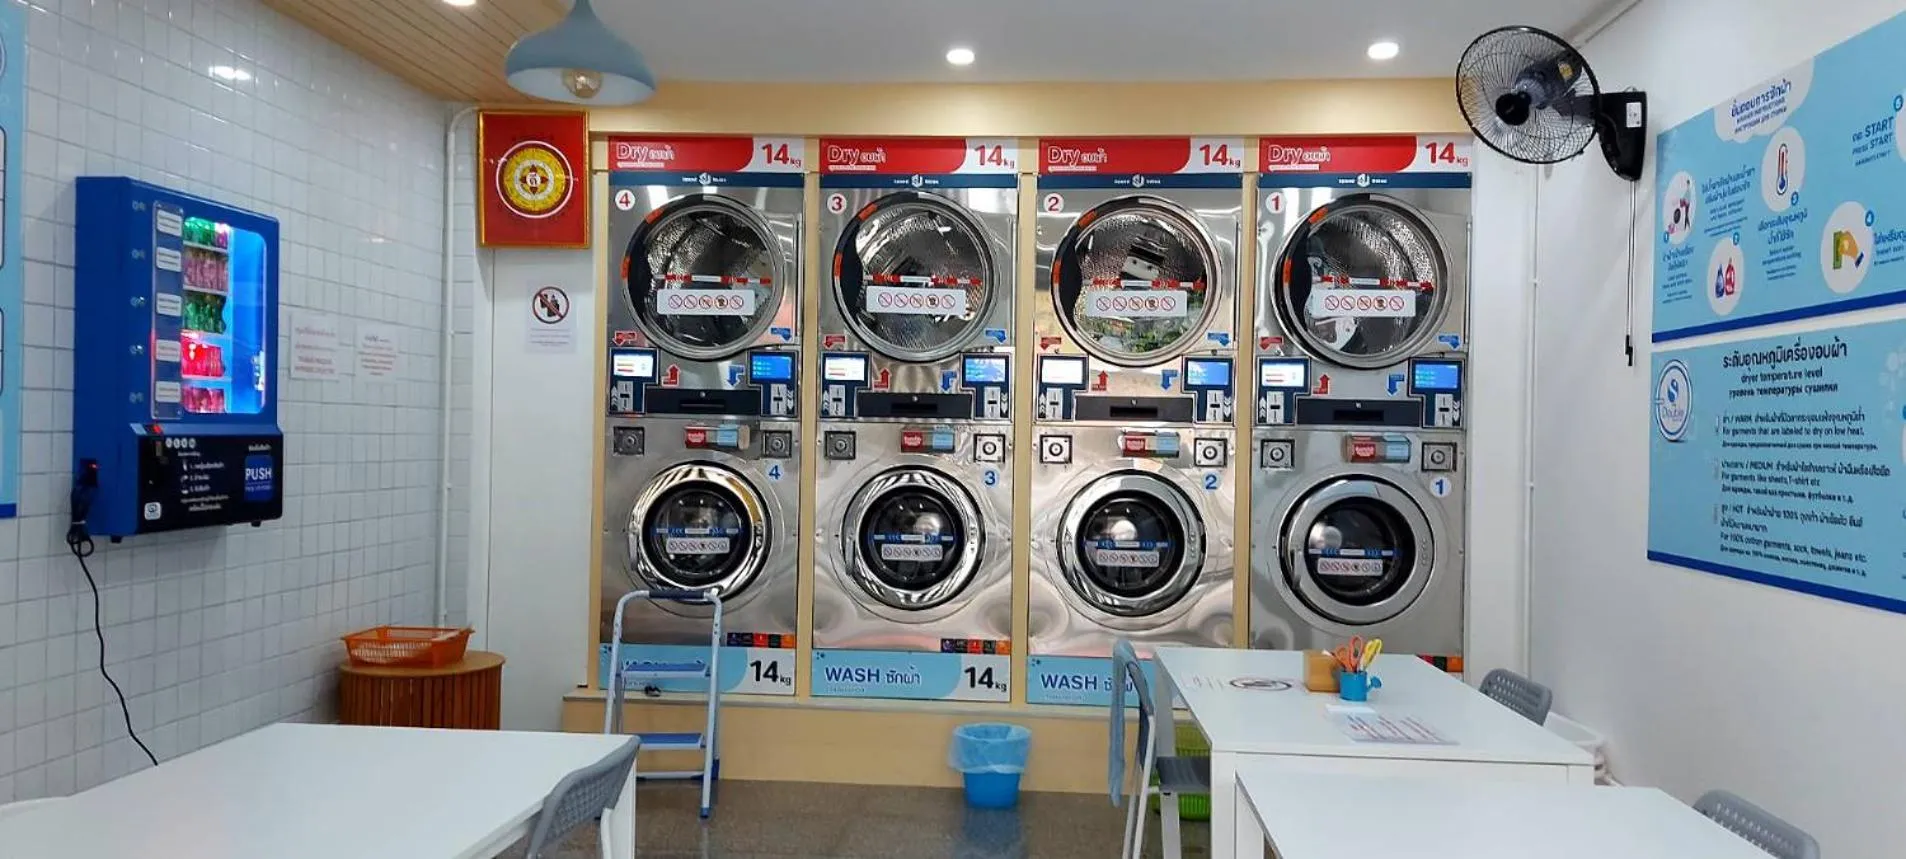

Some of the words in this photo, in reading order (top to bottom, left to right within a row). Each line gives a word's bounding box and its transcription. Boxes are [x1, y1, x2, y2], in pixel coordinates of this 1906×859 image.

[1865, 116, 1894, 137] START
[1870, 132, 1893, 149] START
[616, 142, 648, 164] Dry
[762, 143, 790, 165] 14
[790, 158, 801, 168] kg
[827, 145, 859, 165] Dry
[974, 144, 1003, 166] 14
[1004, 158, 1015, 169] kg
[1048, 146, 1080, 166] Dry
[1200, 144, 1228, 166] 14
[1229, 158, 1240, 168] kg
[1268, 144, 1302, 165] Dry
[1426, 142, 1455, 164] 14
[1457, 157, 1468, 167] kg
[619, 192, 631, 208] 4
[831, 196, 843, 212] 3
[1048, 196, 1060, 212] 2
[1271, 195, 1280, 211] 1
[1722, 336, 1847, 372] ระดับอุณหภูมิเครื่องอบผ้า
[1741, 372, 1759, 385] dryer
[1760, 370, 1803, 383] temperature
[1805, 367, 1823, 379] level
[1722, 426, 1730, 436] For
[1731, 428, 1757, 437] garments
[1812, 427, 1823, 438] dry
[1824, 428, 1833, 436] on
[1834, 426, 1846, 436] low
[245, 467, 272, 481] PUSH
[768, 465, 781, 480] 4
[983, 470, 997, 486] 3
[1721, 471, 1730, 480] For
[1731, 474, 1756, 482] garments
[1205, 474, 1218, 490] 2
[1435, 479, 1445, 495] 1
[750, 660, 779, 682] 14
[779, 675, 792, 686] kg
[825, 667, 880, 683] WASH
[885, 663, 921, 685] ซักผ้า
[964, 667, 994, 689] 14
[995, 682, 1007, 693] kg
[1041, 673, 1097, 690] WASH
